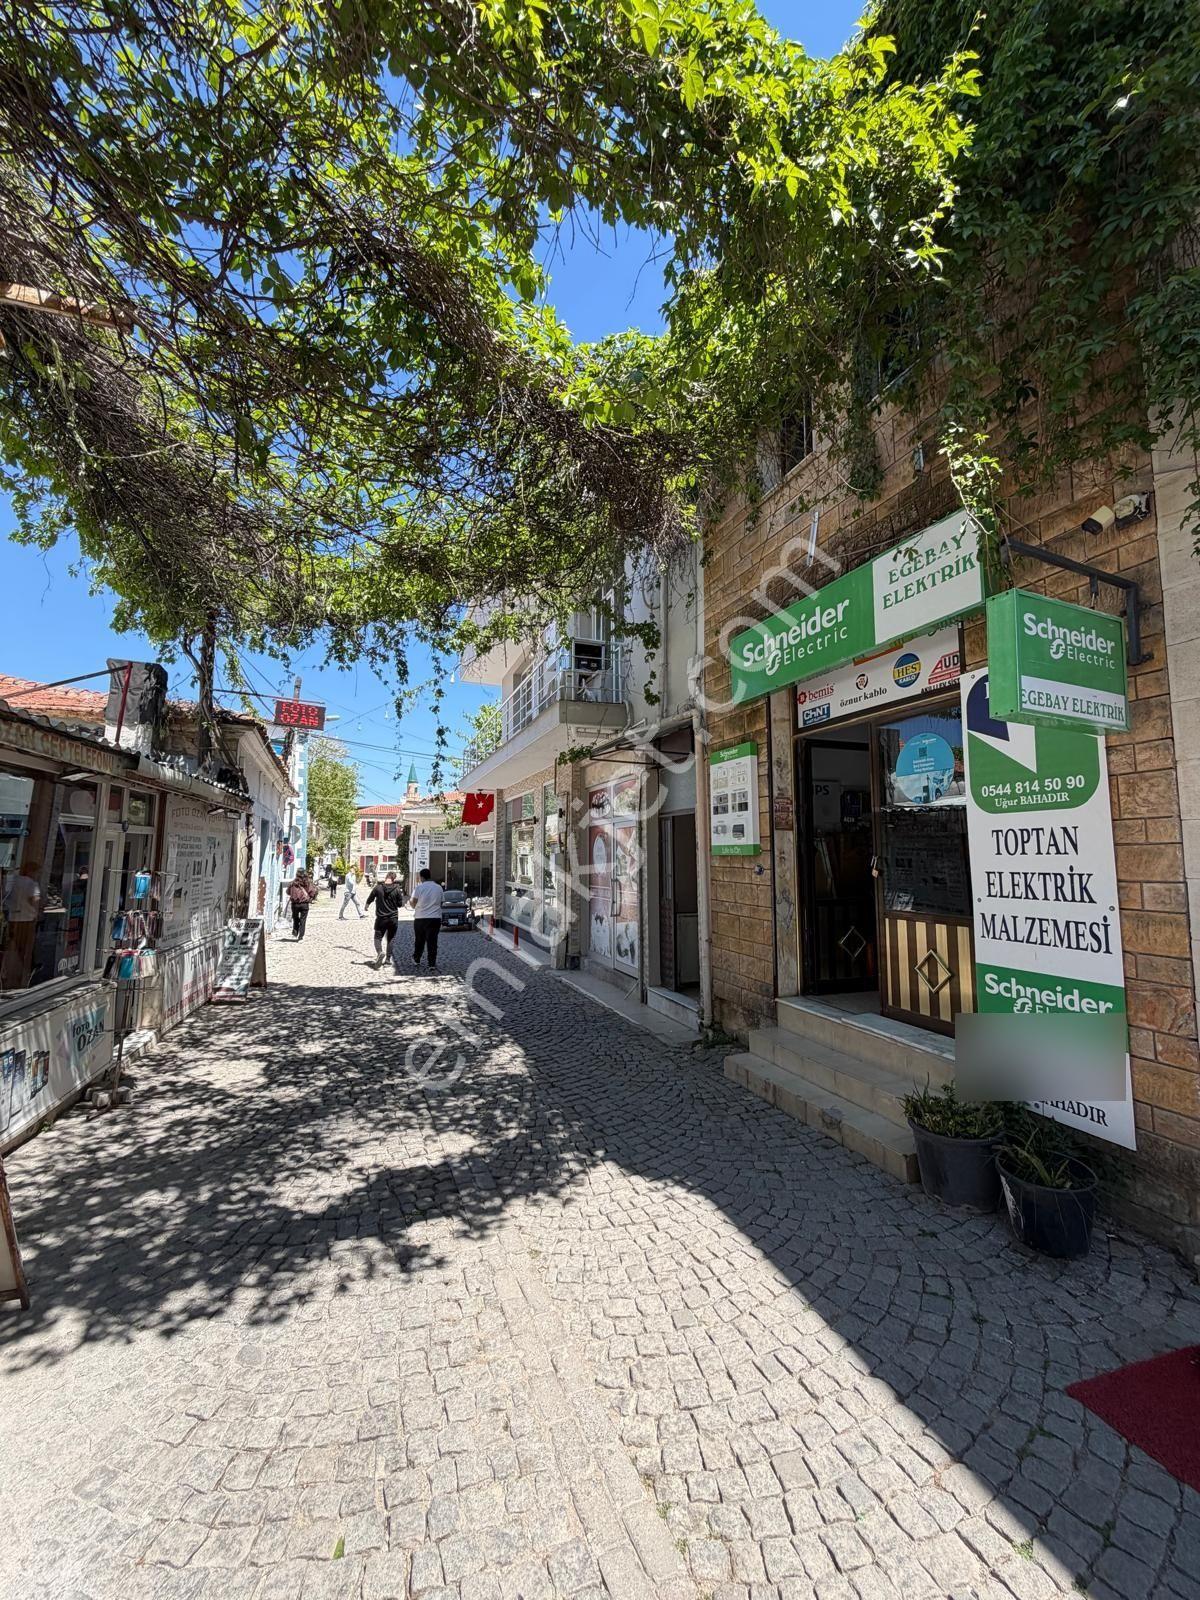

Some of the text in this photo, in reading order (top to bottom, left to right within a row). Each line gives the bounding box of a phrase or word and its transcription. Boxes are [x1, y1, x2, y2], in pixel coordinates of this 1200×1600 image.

[888, 534, 964, 585] EGEBAY
[882, 552, 976, 609] ELEKTRİK
[743, 599, 849, 667] Schneider
[783, 626, 848, 665] Electric
[1023, 612, 1115, 655] Schneider
[897, 664, 917, 678] HES
[1067, 646, 1115, 669] Electric
[808, 683, 835, 701] bemis
[899, 674, 916, 684] KABLO
[282, 702, 318, 715] FOTO
[840, 695, 862, 708] öznur
[864, 687, 887, 701] kablo
[1021, 689, 1125, 722] EGEBAY ELEKTRİK
[280, 712, 319, 726] OZAN
[982, 775, 1085, 797] 0544 814 50 90
[995, 792, 1070, 808] Uğur BAHADIR
[992, 826, 1079, 856] TOPTAN
[985, 865, 1097, 904] ELEKTRİK
[980, 912, 1113, 954] MALZEMESİ
[984, 973, 1113, 1014] Schneider
